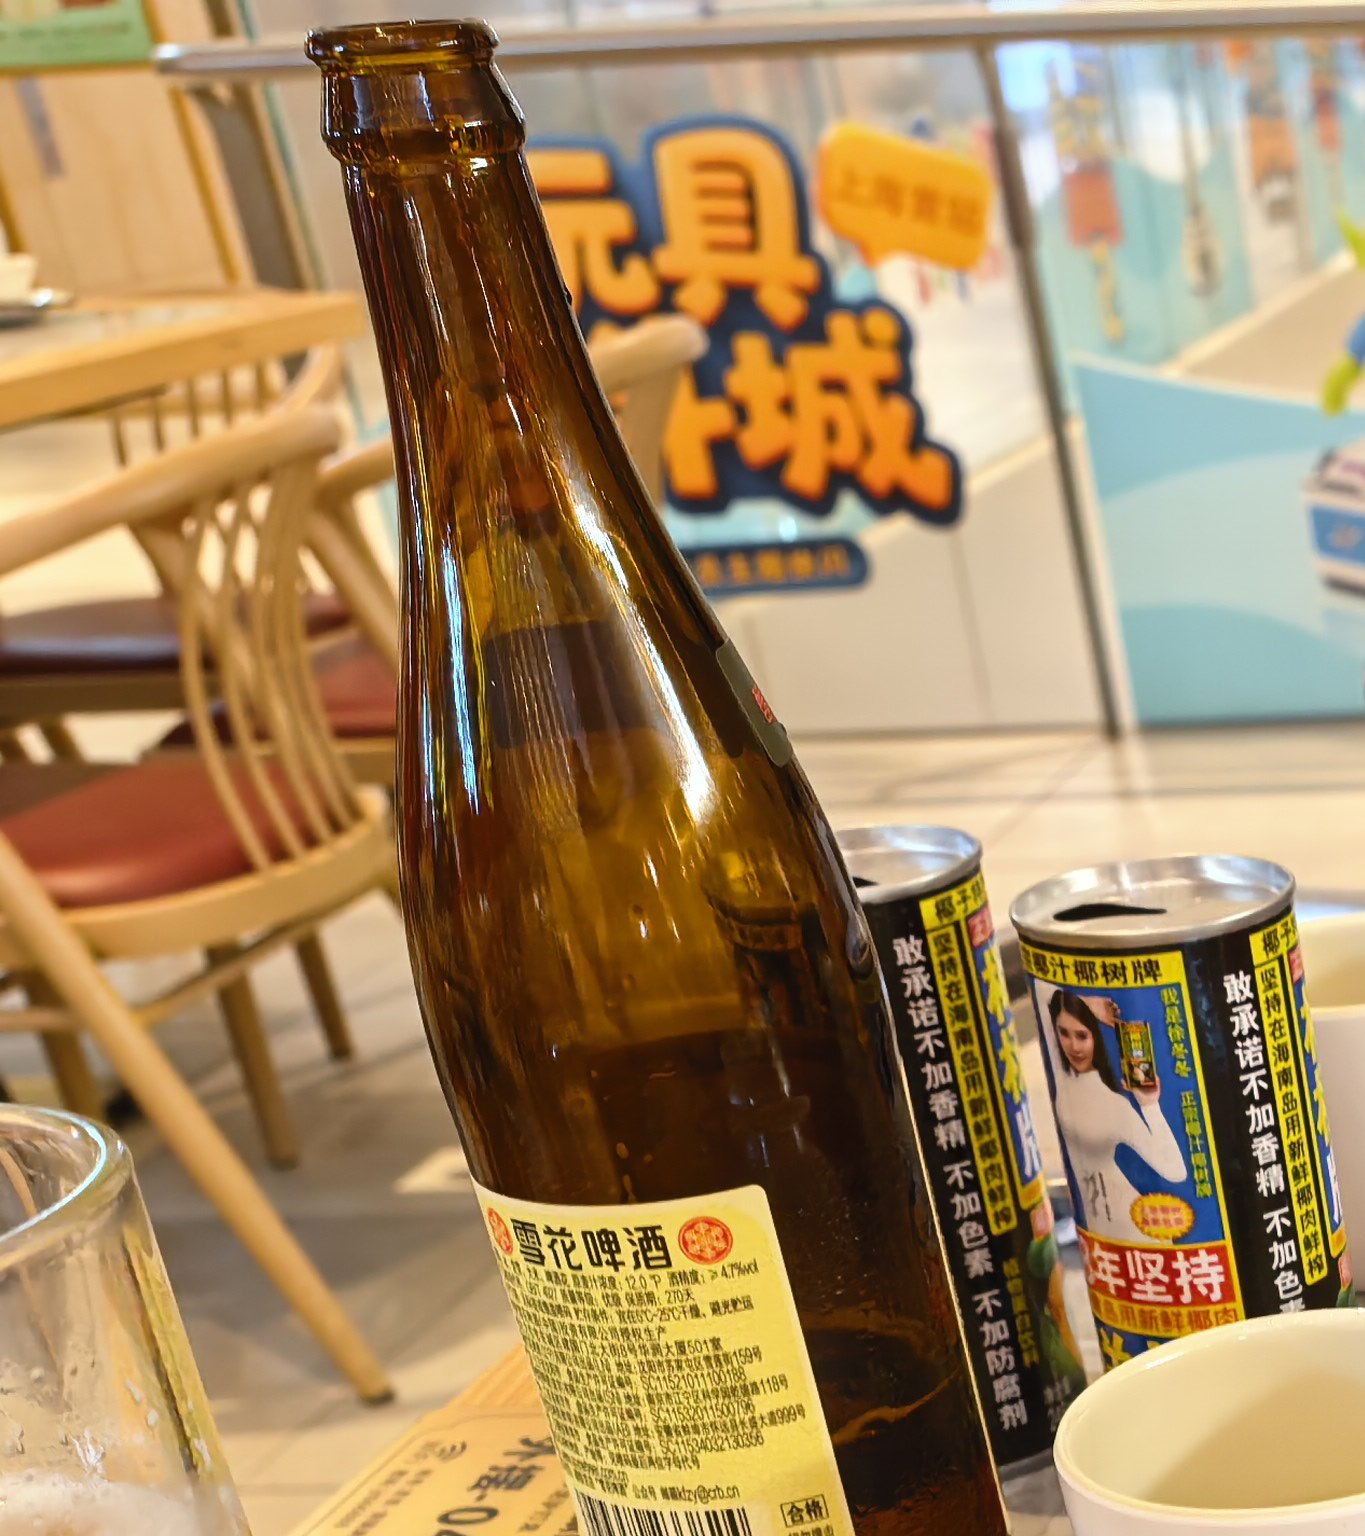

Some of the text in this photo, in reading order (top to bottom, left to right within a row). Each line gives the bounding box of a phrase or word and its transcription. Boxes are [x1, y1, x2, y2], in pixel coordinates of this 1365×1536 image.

[893, 934, 966, 1151] 敢承诺不加香精
[943, 1160, 994, 1279] 不加色素
[1223, 969, 1285, 1198] 敢承诺不加香精
[1260, 967, 1325, 1281] 坚持在海南岛用新鲜椰肉鲜榨
[510, 1217, 673, 1272] 雪花啤酒
[1081, 1236, 1226, 1304] 年坚持
[787, 1498, 823, 1525] 合格
